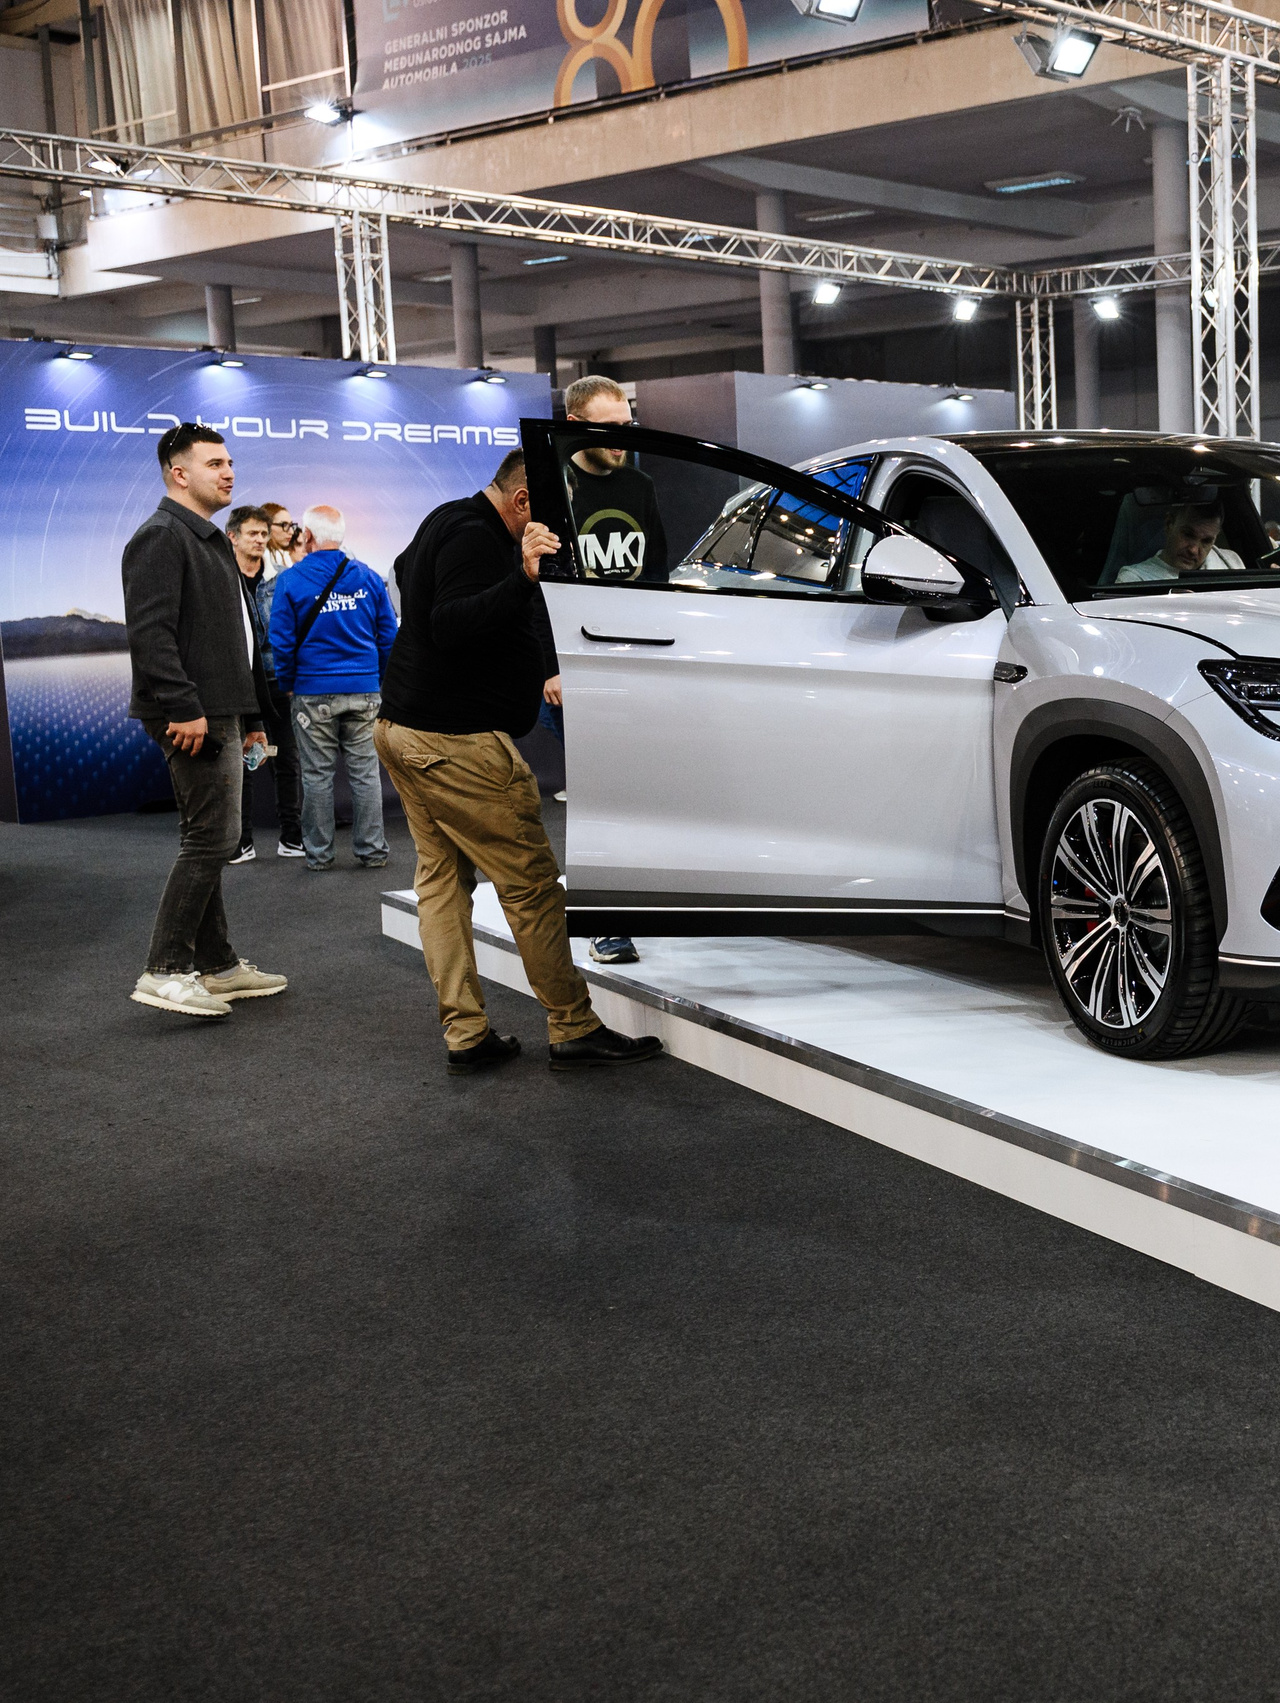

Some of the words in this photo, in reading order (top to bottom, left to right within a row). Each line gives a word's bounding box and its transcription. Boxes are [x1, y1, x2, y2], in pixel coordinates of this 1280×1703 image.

[384, 26, 448, 55] GENERALNI
[451, 9, 508, 37] SPONZOR
[484, 24, 527, 48] SAJMA
[382, 61, 458, 90] AUTOMOBILA
[463, 53, 492, 70] 2025
[24, 408, 181, 434] BUILD
[342, 420, 520, 446] DREAMS
[578, 531, 646, 570] MK
